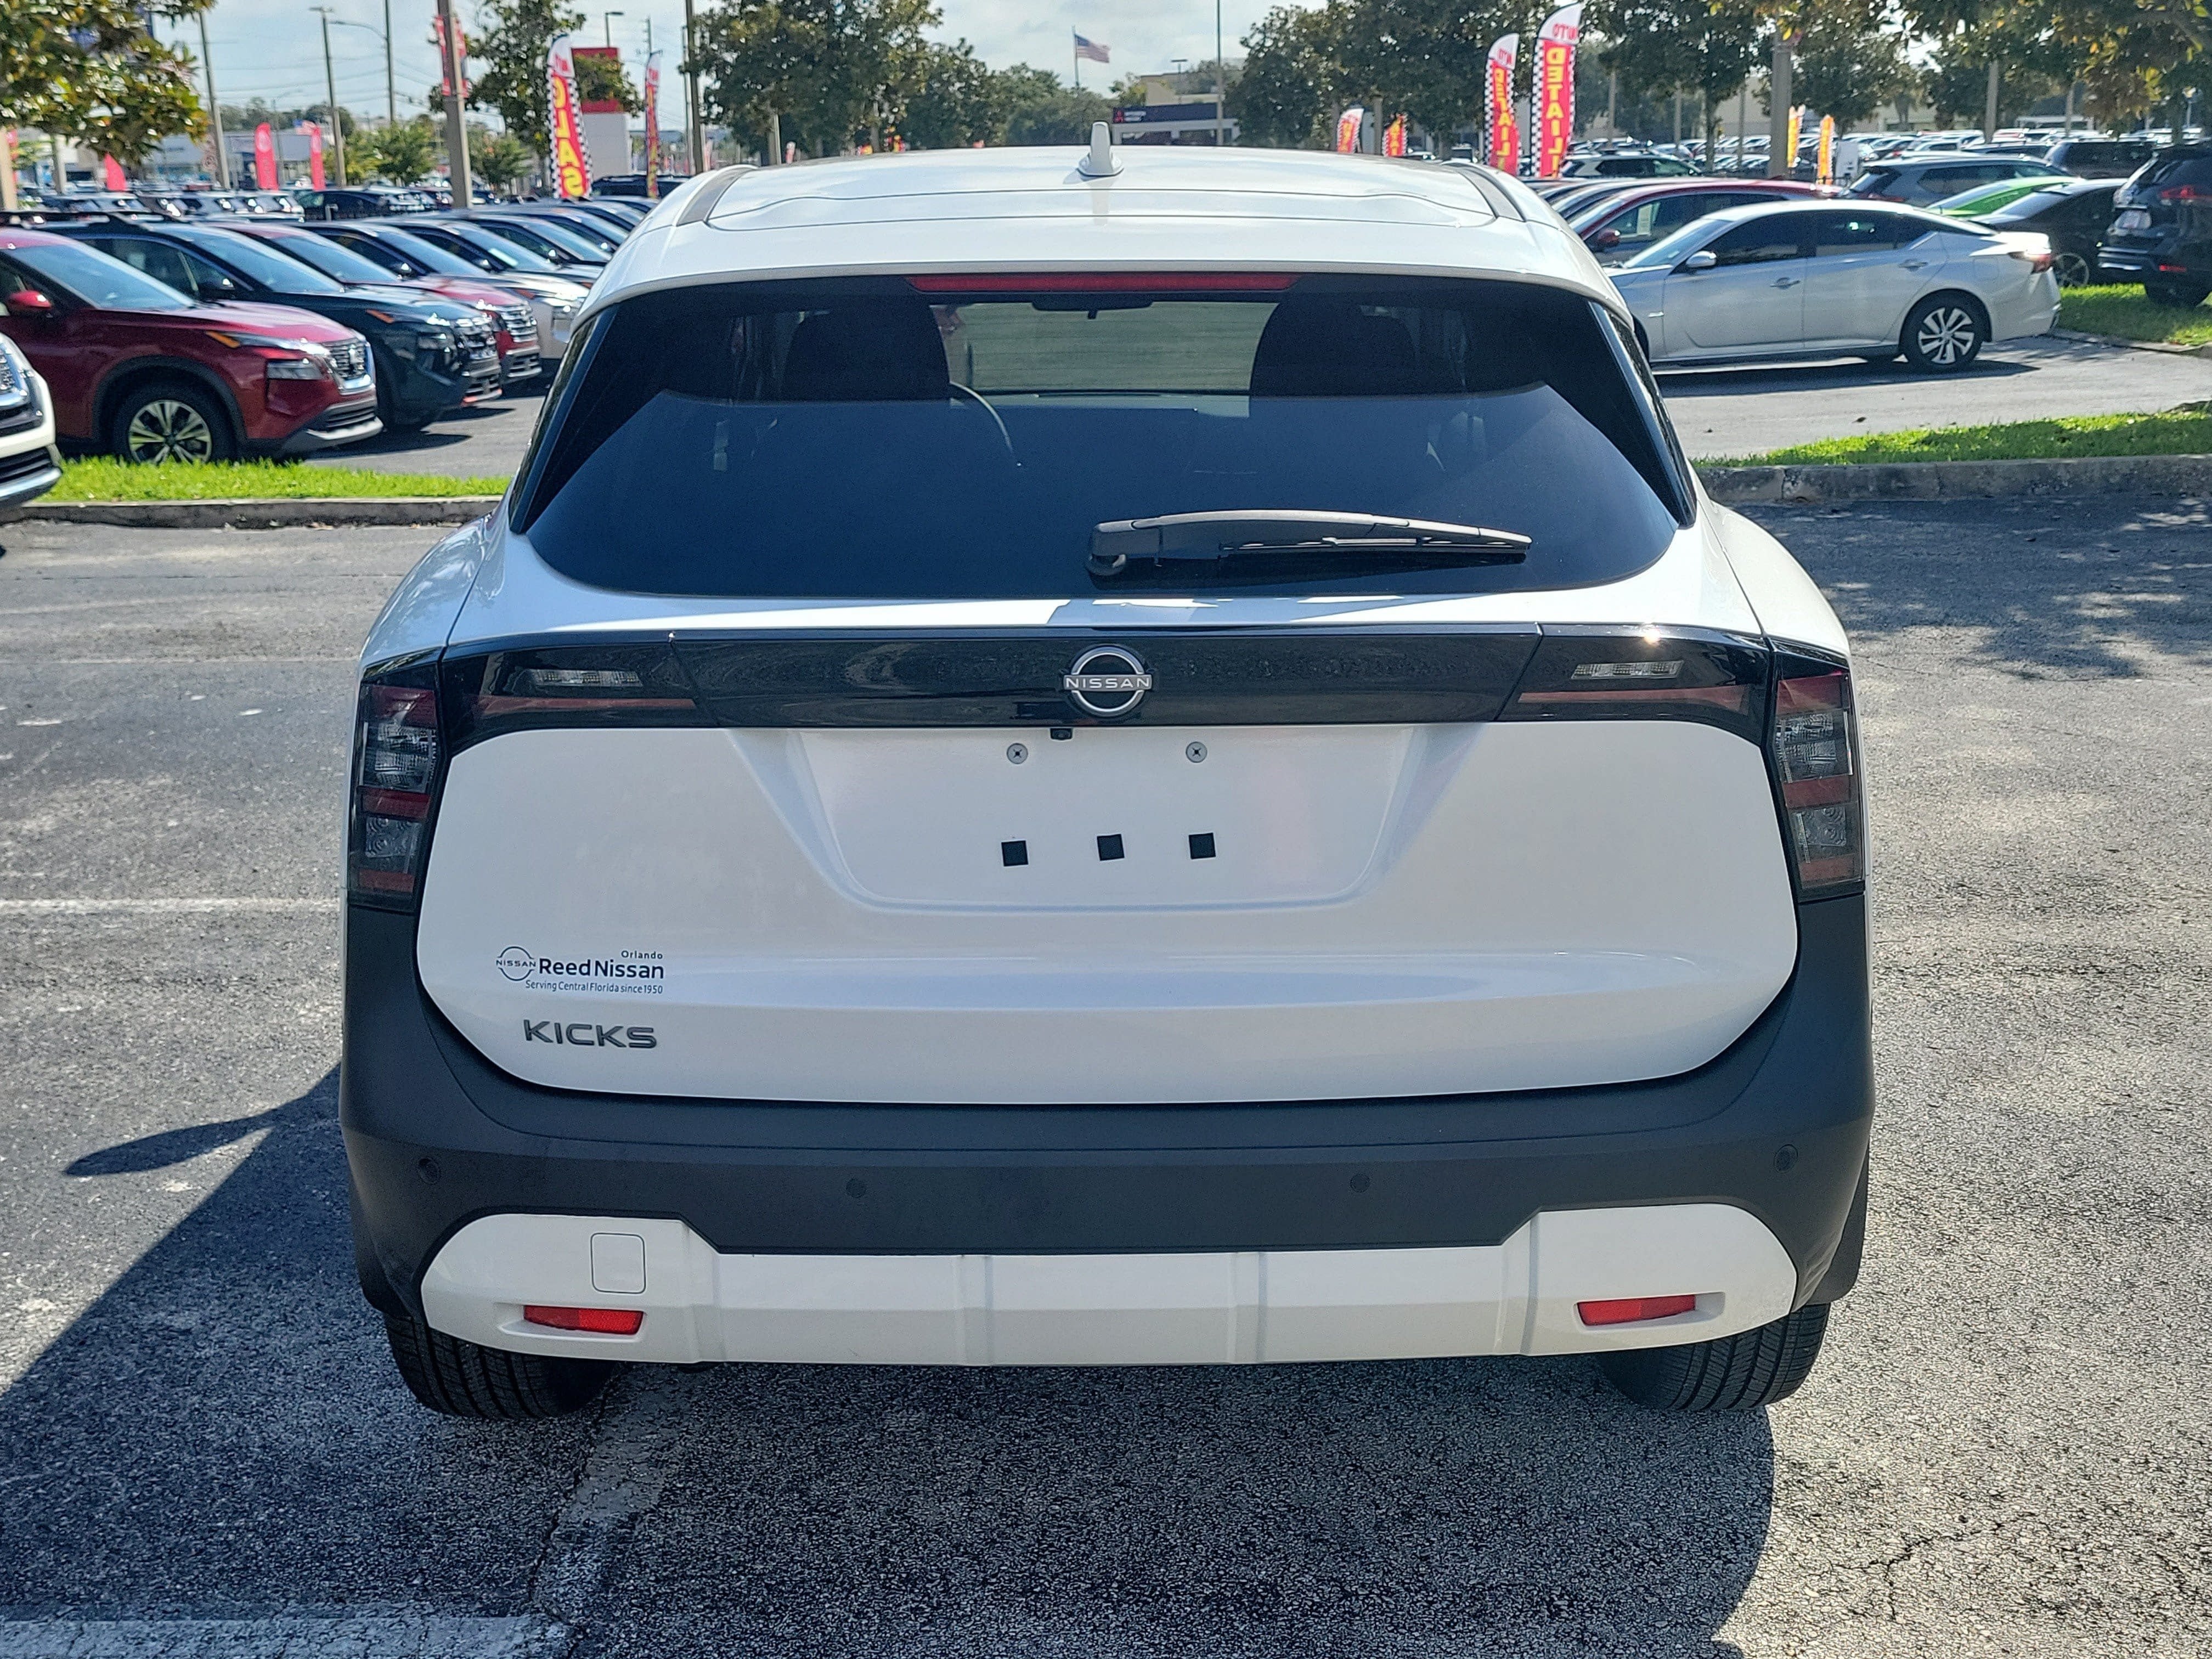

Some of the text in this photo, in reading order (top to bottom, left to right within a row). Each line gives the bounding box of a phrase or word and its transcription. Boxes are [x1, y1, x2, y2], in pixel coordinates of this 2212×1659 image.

[1065, 678, 1150, 689] NISSAN
[621, 950, 663, 959] Orlando
[539, 958, 664, 979] Reed Nissan
[526, 980, 663, 994] Serving Central Florida since 1950
[523, 1019, 657, 1048] KICKS
